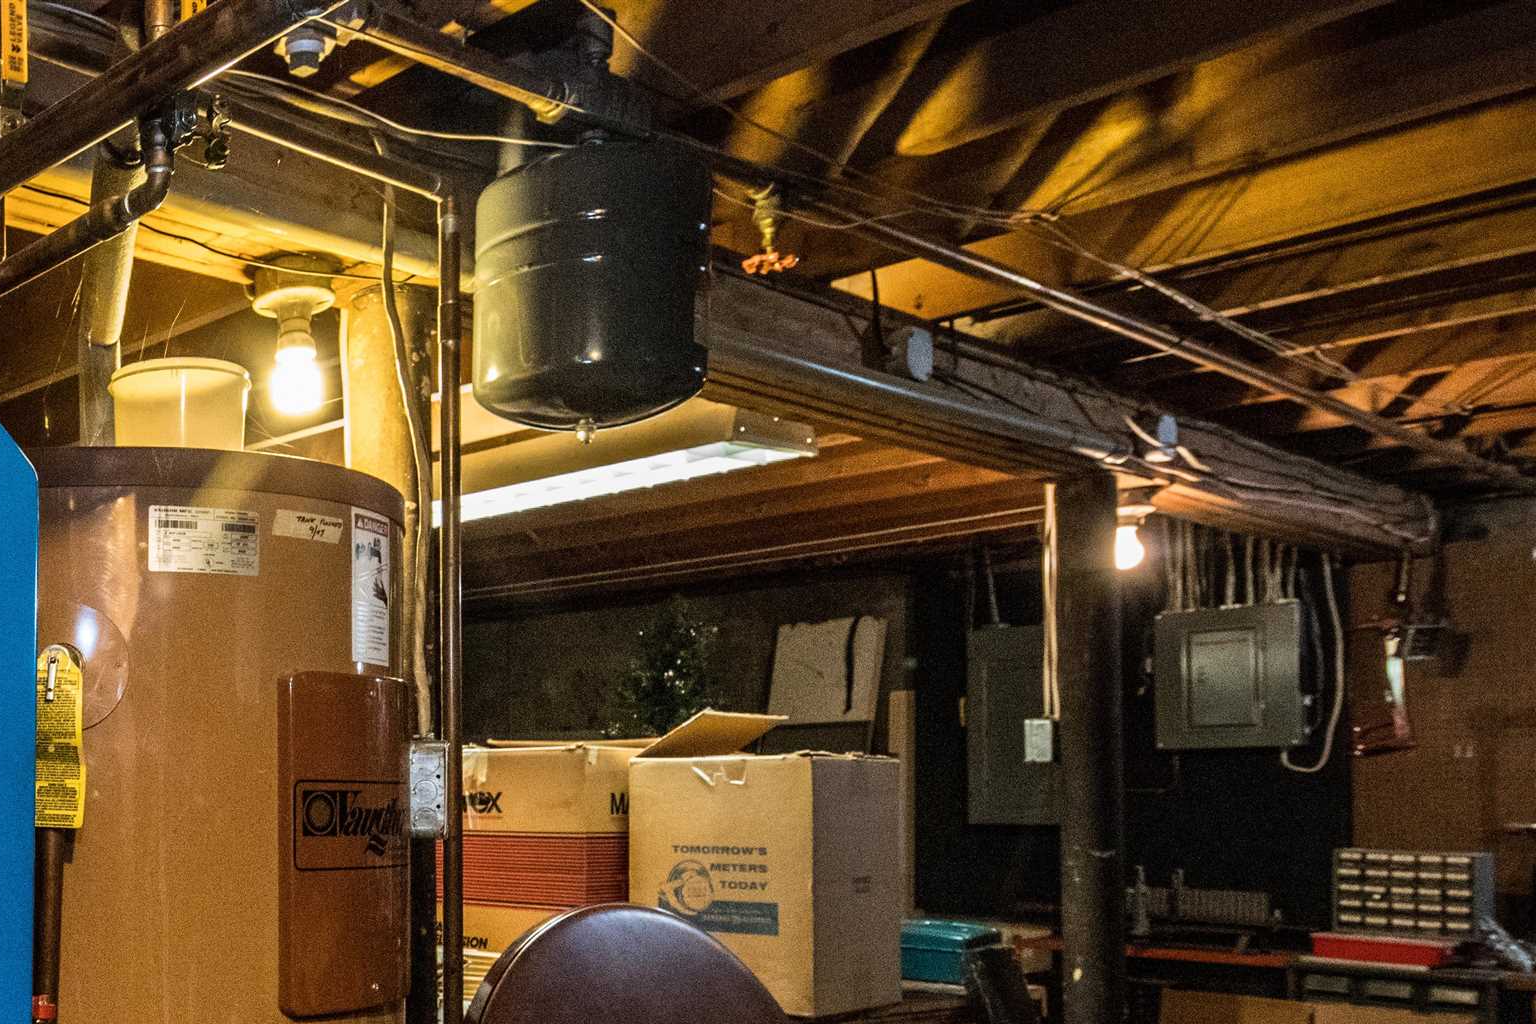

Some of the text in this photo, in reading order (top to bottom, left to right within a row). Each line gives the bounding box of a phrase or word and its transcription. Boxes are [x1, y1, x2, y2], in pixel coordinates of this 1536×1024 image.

[671, 844, 768, 856] TOMORROW'S
[710, 863, 768, 873] METERS
[720, 880, 768, 890] TODAY
